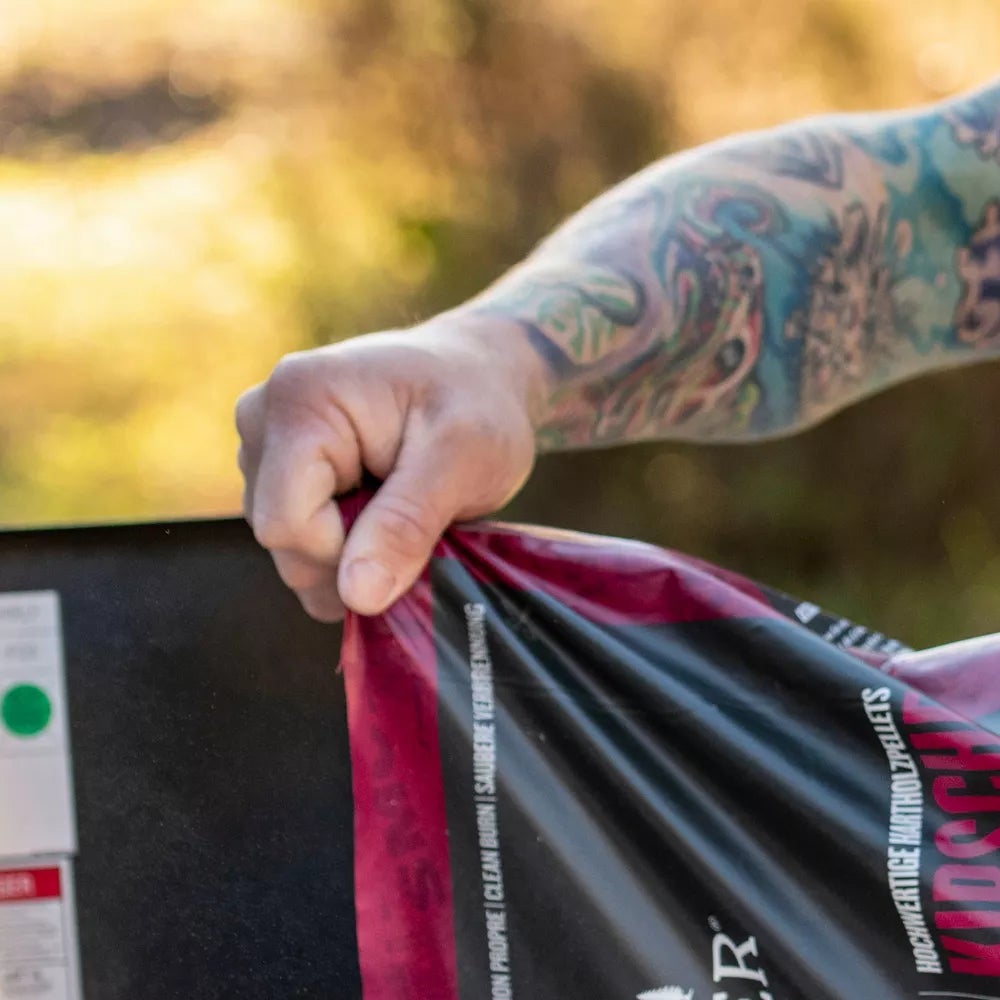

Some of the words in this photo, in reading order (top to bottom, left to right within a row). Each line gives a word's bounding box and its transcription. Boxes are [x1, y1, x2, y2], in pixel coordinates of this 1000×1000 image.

[472, 722, 496, 794] SAUBERE
[861, 686, 924, 845] HARTHOLZPELLETS
[475, 803, 499, 848] BURN
[480, 850, 504, 900] CLEAN
[485, 910, 509, 972] PROPRE
[887, 846, 944, 974] HOCHWERTIGE
